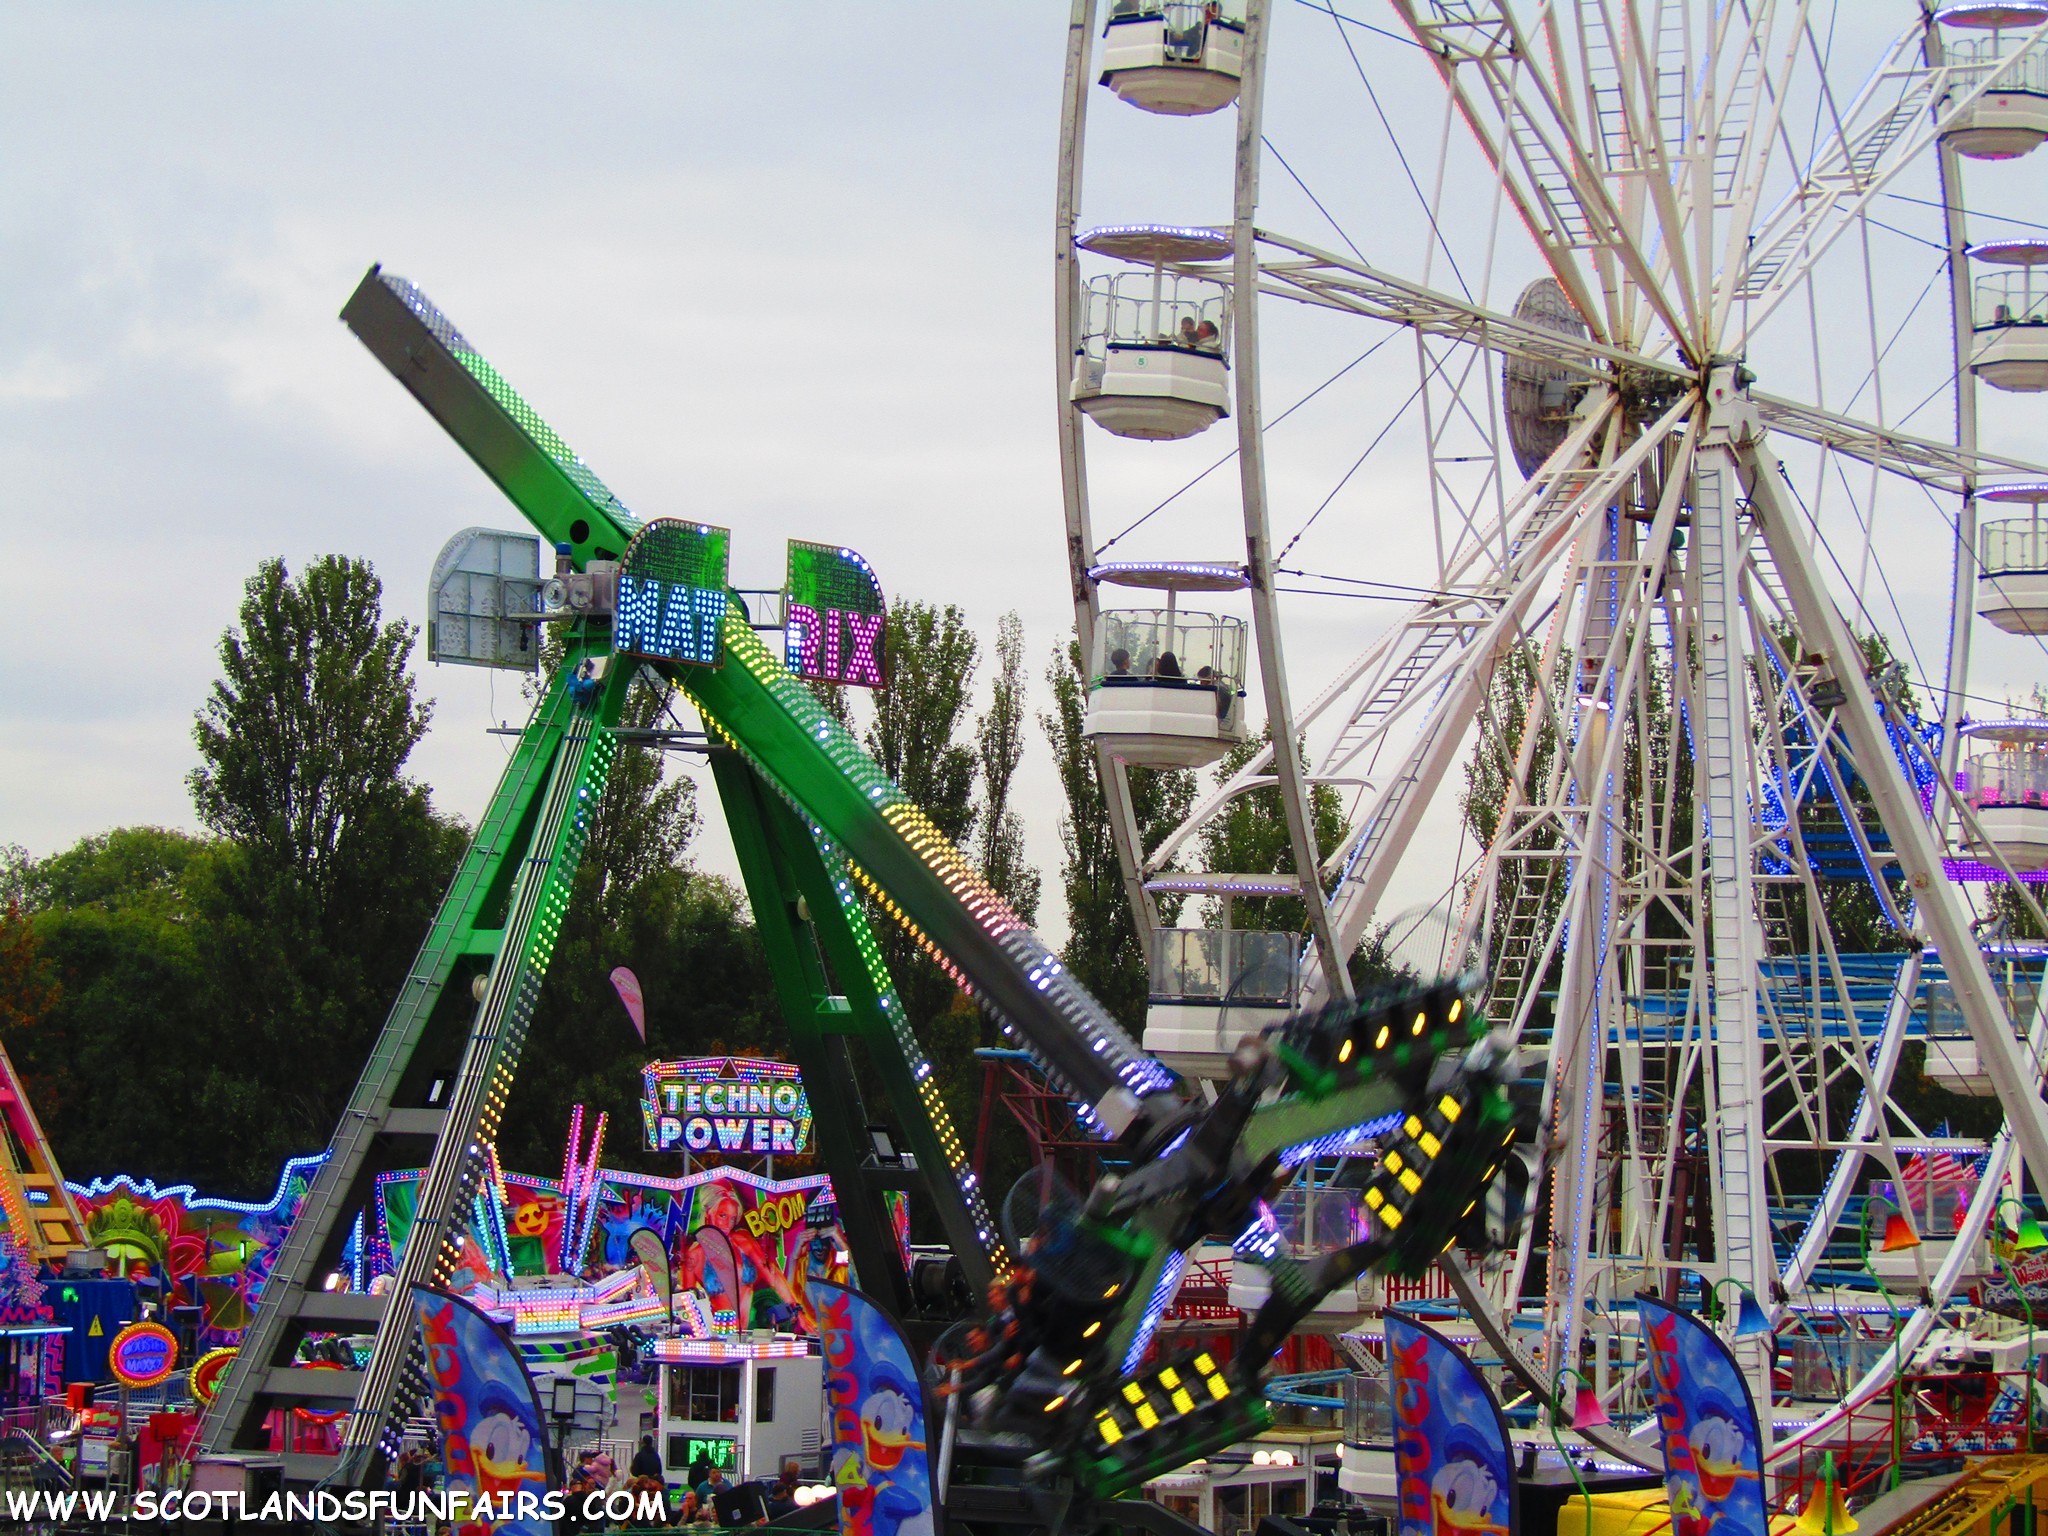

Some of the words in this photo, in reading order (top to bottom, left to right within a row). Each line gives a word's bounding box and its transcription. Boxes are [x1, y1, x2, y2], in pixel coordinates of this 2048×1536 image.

[616, 574, 727, 662] MAT
[785, 603, 885, 685] RIX
[658, 1115, 797, 1154] POWER
[661, 1081, 799, 1115] TECHNO
[743, 1192, 805, 1238] BOOM
[420, 1302, 475, 1477] DUCK
[817, 1292, 862, 1446] DUCK
[1391, 1335, 1432, 1525] DUCK
[1645, 1313, 1697, 1475] DUCK
